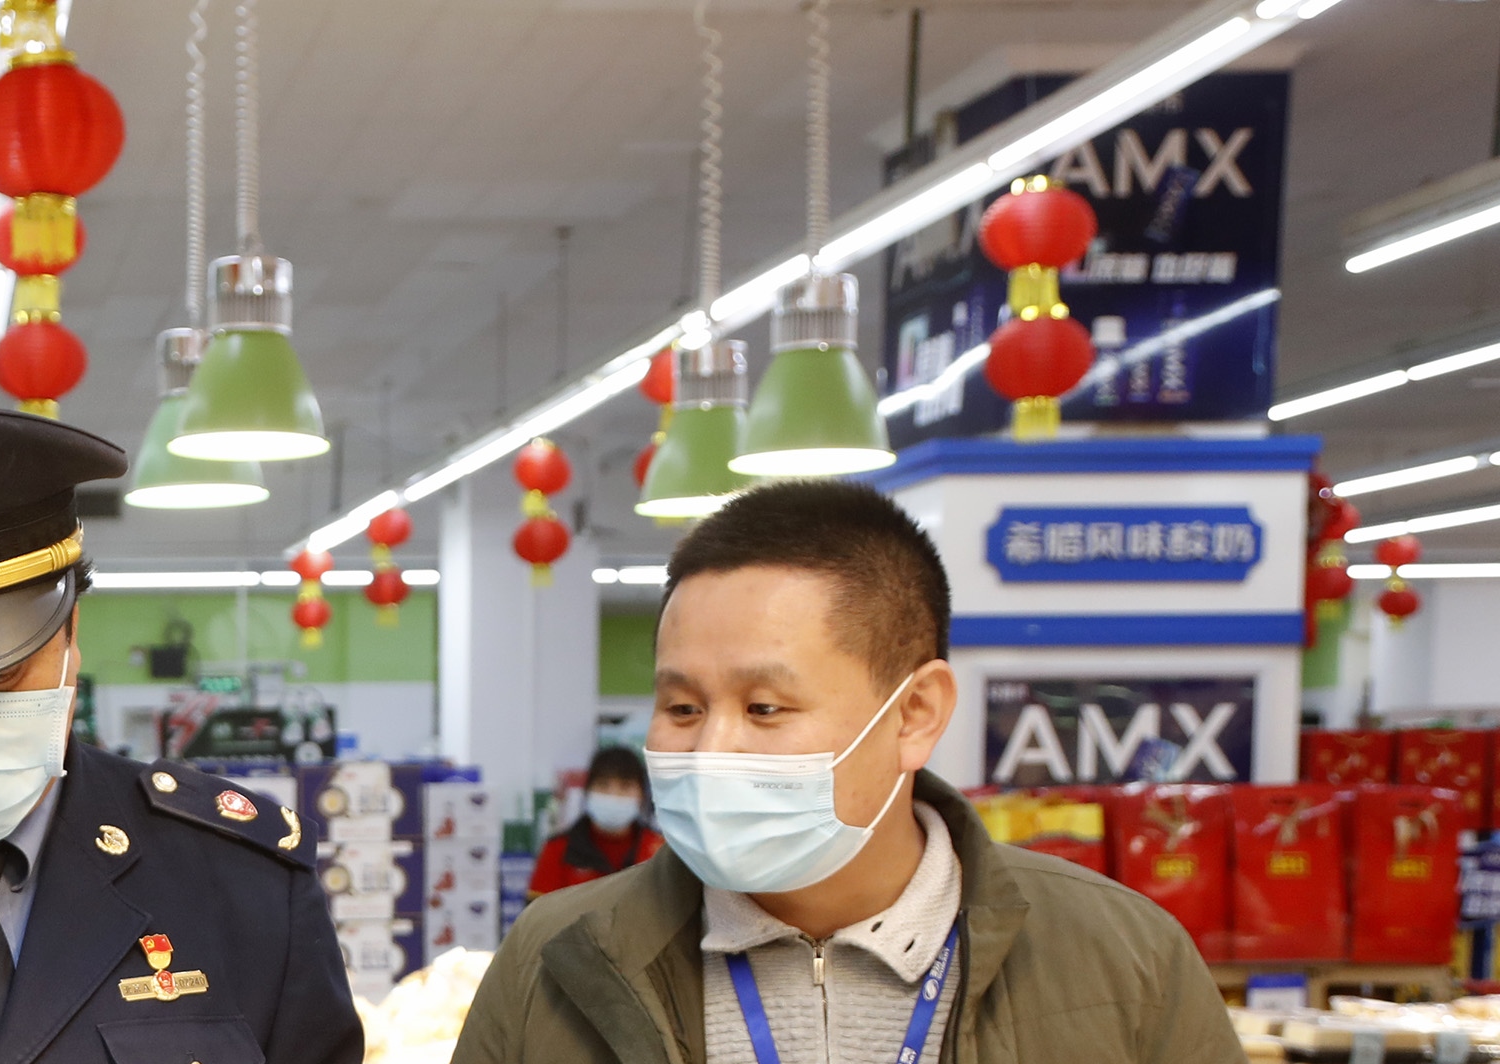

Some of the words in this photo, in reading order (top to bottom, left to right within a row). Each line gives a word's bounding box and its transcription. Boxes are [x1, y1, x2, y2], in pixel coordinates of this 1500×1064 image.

[1051, 126, 1254, 198] AMX
[1004, 520, 1255, 564] 希腊风味酸奶
[993, 702, 1240, 783] AMX
